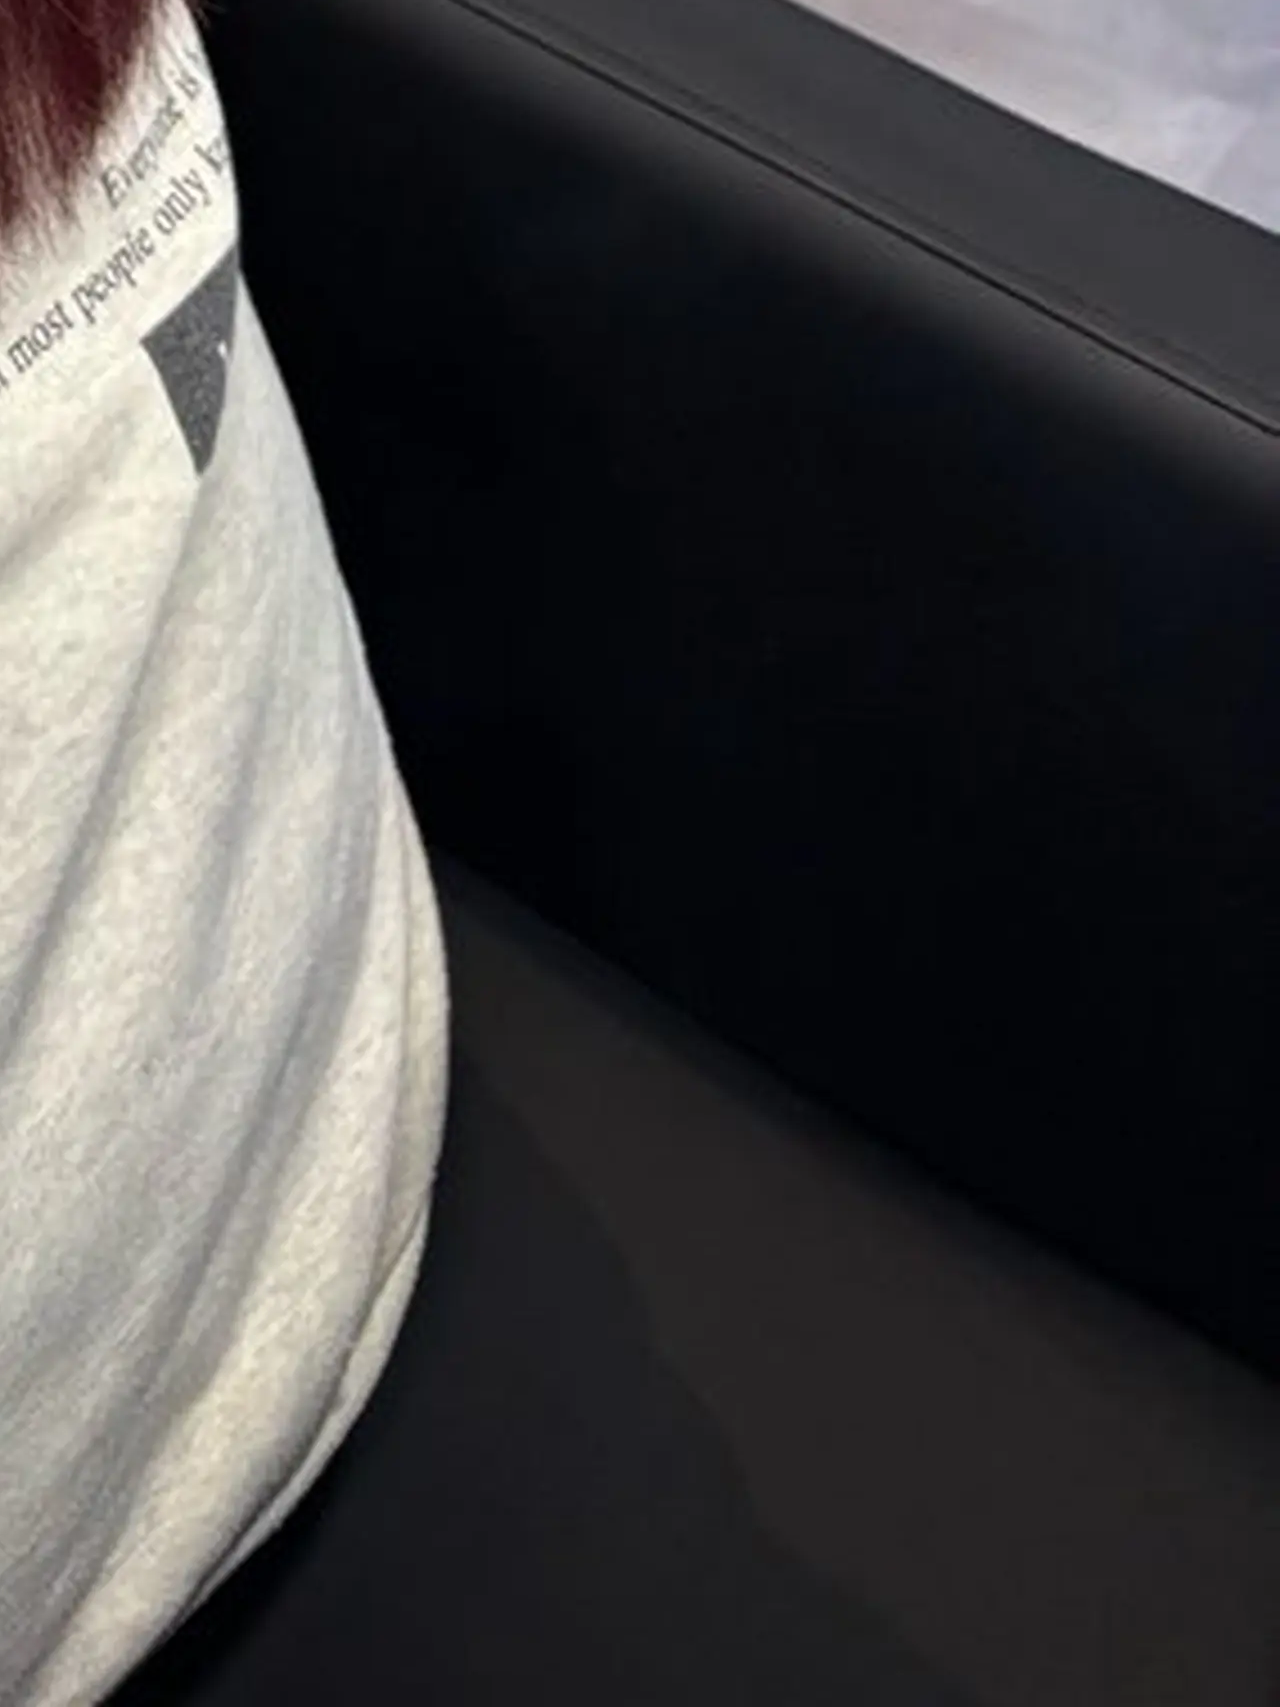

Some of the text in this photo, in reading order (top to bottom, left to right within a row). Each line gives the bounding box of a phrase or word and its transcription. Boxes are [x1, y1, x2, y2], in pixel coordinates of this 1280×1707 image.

[7, 299, 74, 375] most
[70, 226, 156, 325] people
[153, 167, 212, 237] only
